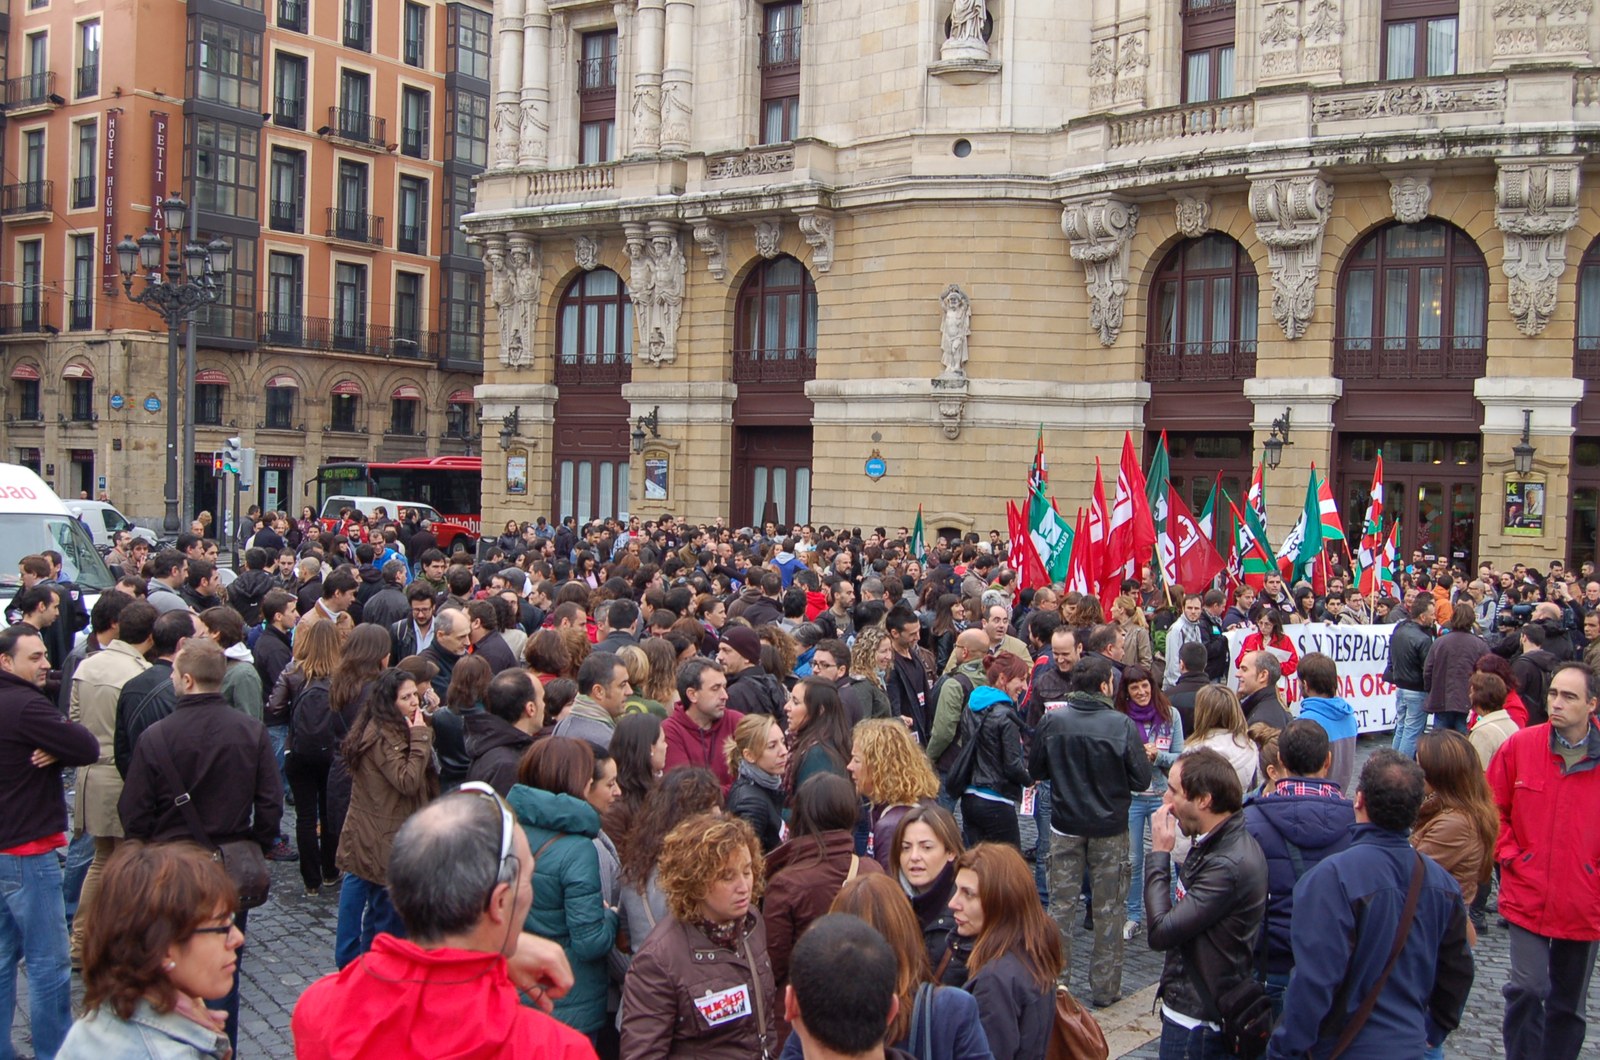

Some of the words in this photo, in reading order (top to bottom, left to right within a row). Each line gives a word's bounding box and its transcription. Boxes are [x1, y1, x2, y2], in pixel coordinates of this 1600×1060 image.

[107, 118, 116, 170] HOTEL
[156, 121, 166, 182] PETIT
[105, 176, 114, 217] HIGH
[104, 223, 113, 264] TECH
